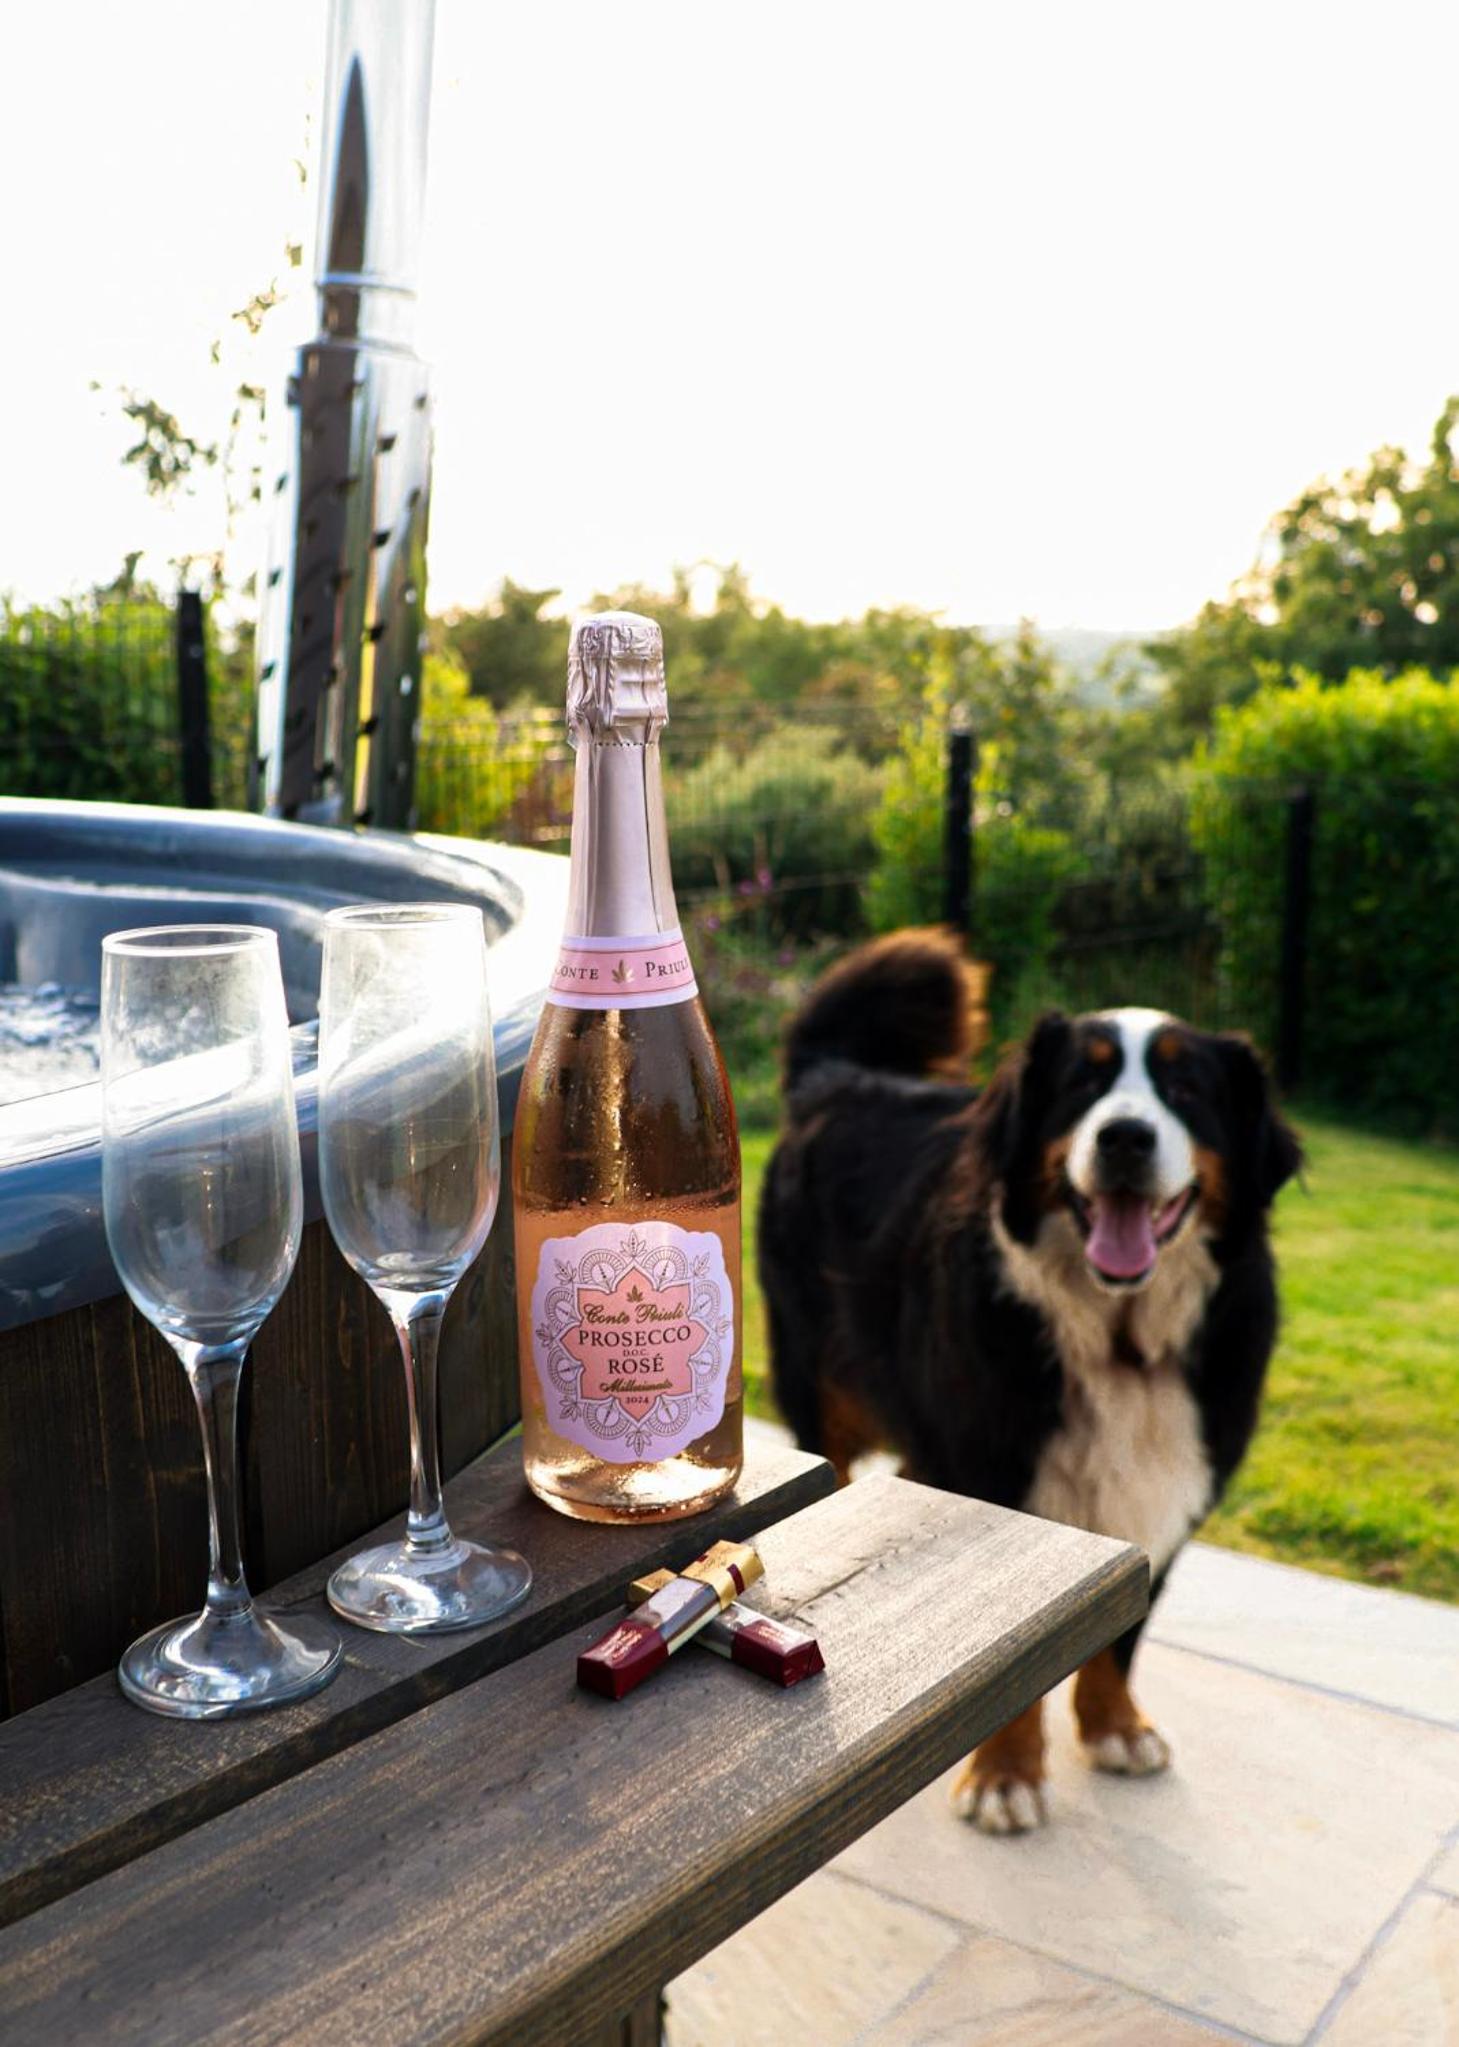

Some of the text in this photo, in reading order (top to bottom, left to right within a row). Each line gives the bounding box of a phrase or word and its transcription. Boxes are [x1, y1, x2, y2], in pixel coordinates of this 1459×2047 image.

[583, 1301, 685, 1325] Conte Priuli
[578, 1325, 691, 1348] PROSECCO
[608, 1353, 665, 1375] ROSÉ
[625, 1396, 649, 1404] 2024
